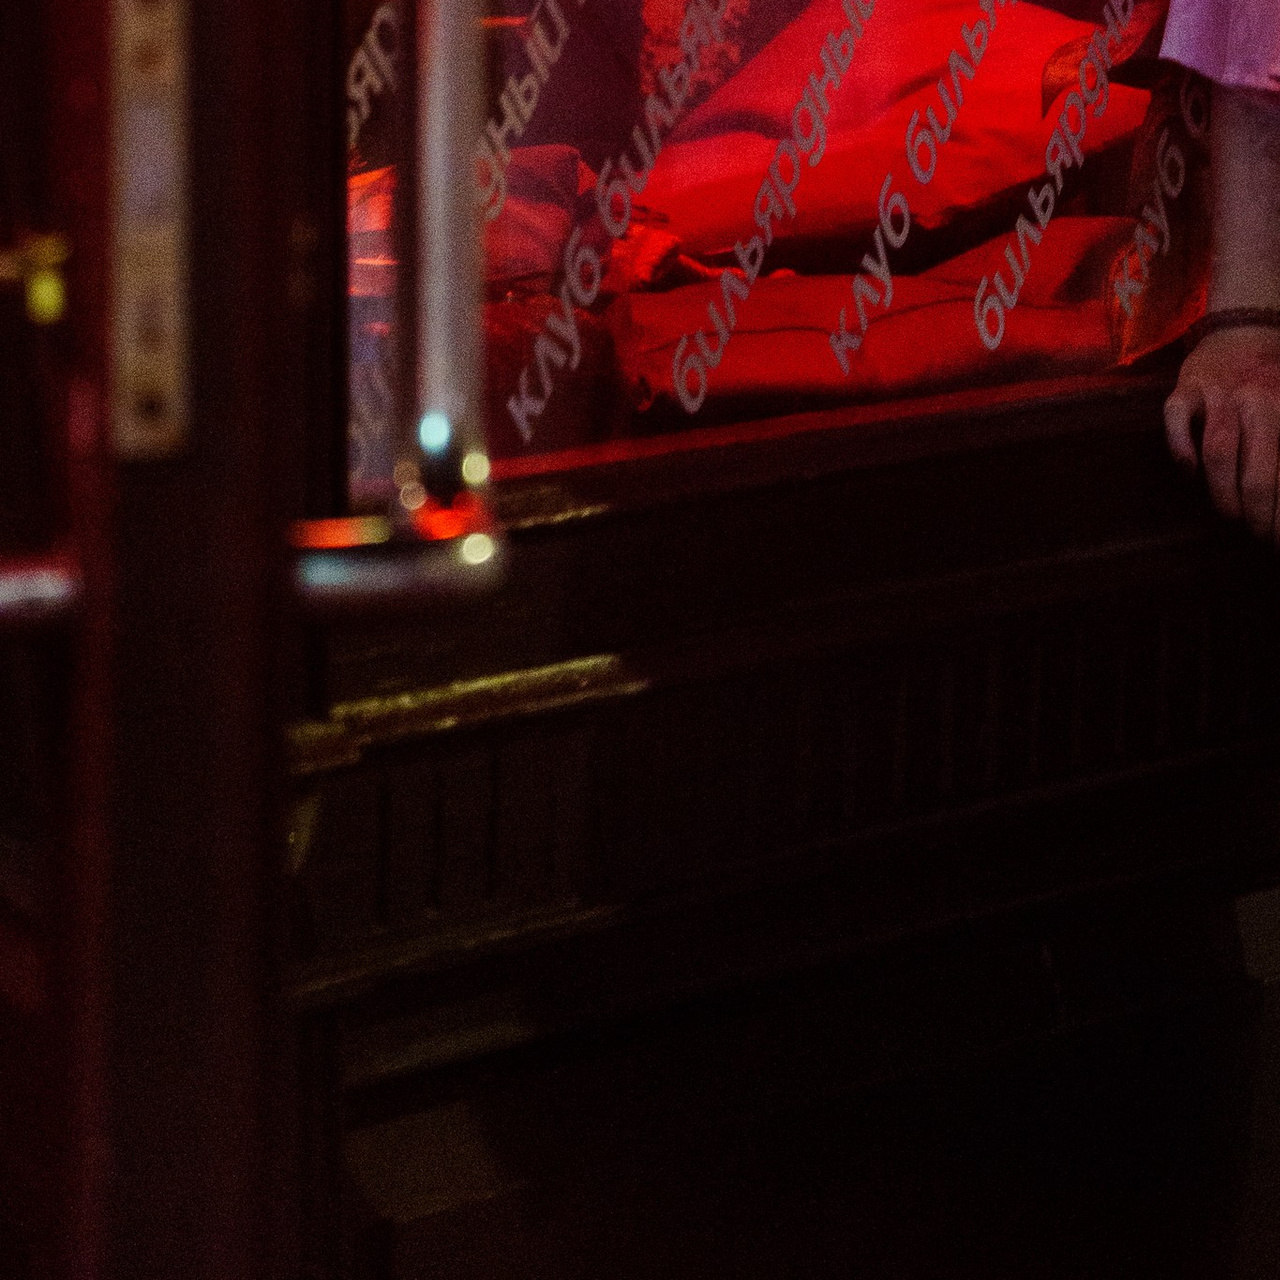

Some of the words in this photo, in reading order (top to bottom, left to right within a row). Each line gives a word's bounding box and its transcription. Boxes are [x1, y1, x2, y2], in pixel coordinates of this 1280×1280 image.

[826, 174, 910, 375] клуб
[1112, 128, 1186, 318] клуб
[506, 226, 604, 442] клуб
